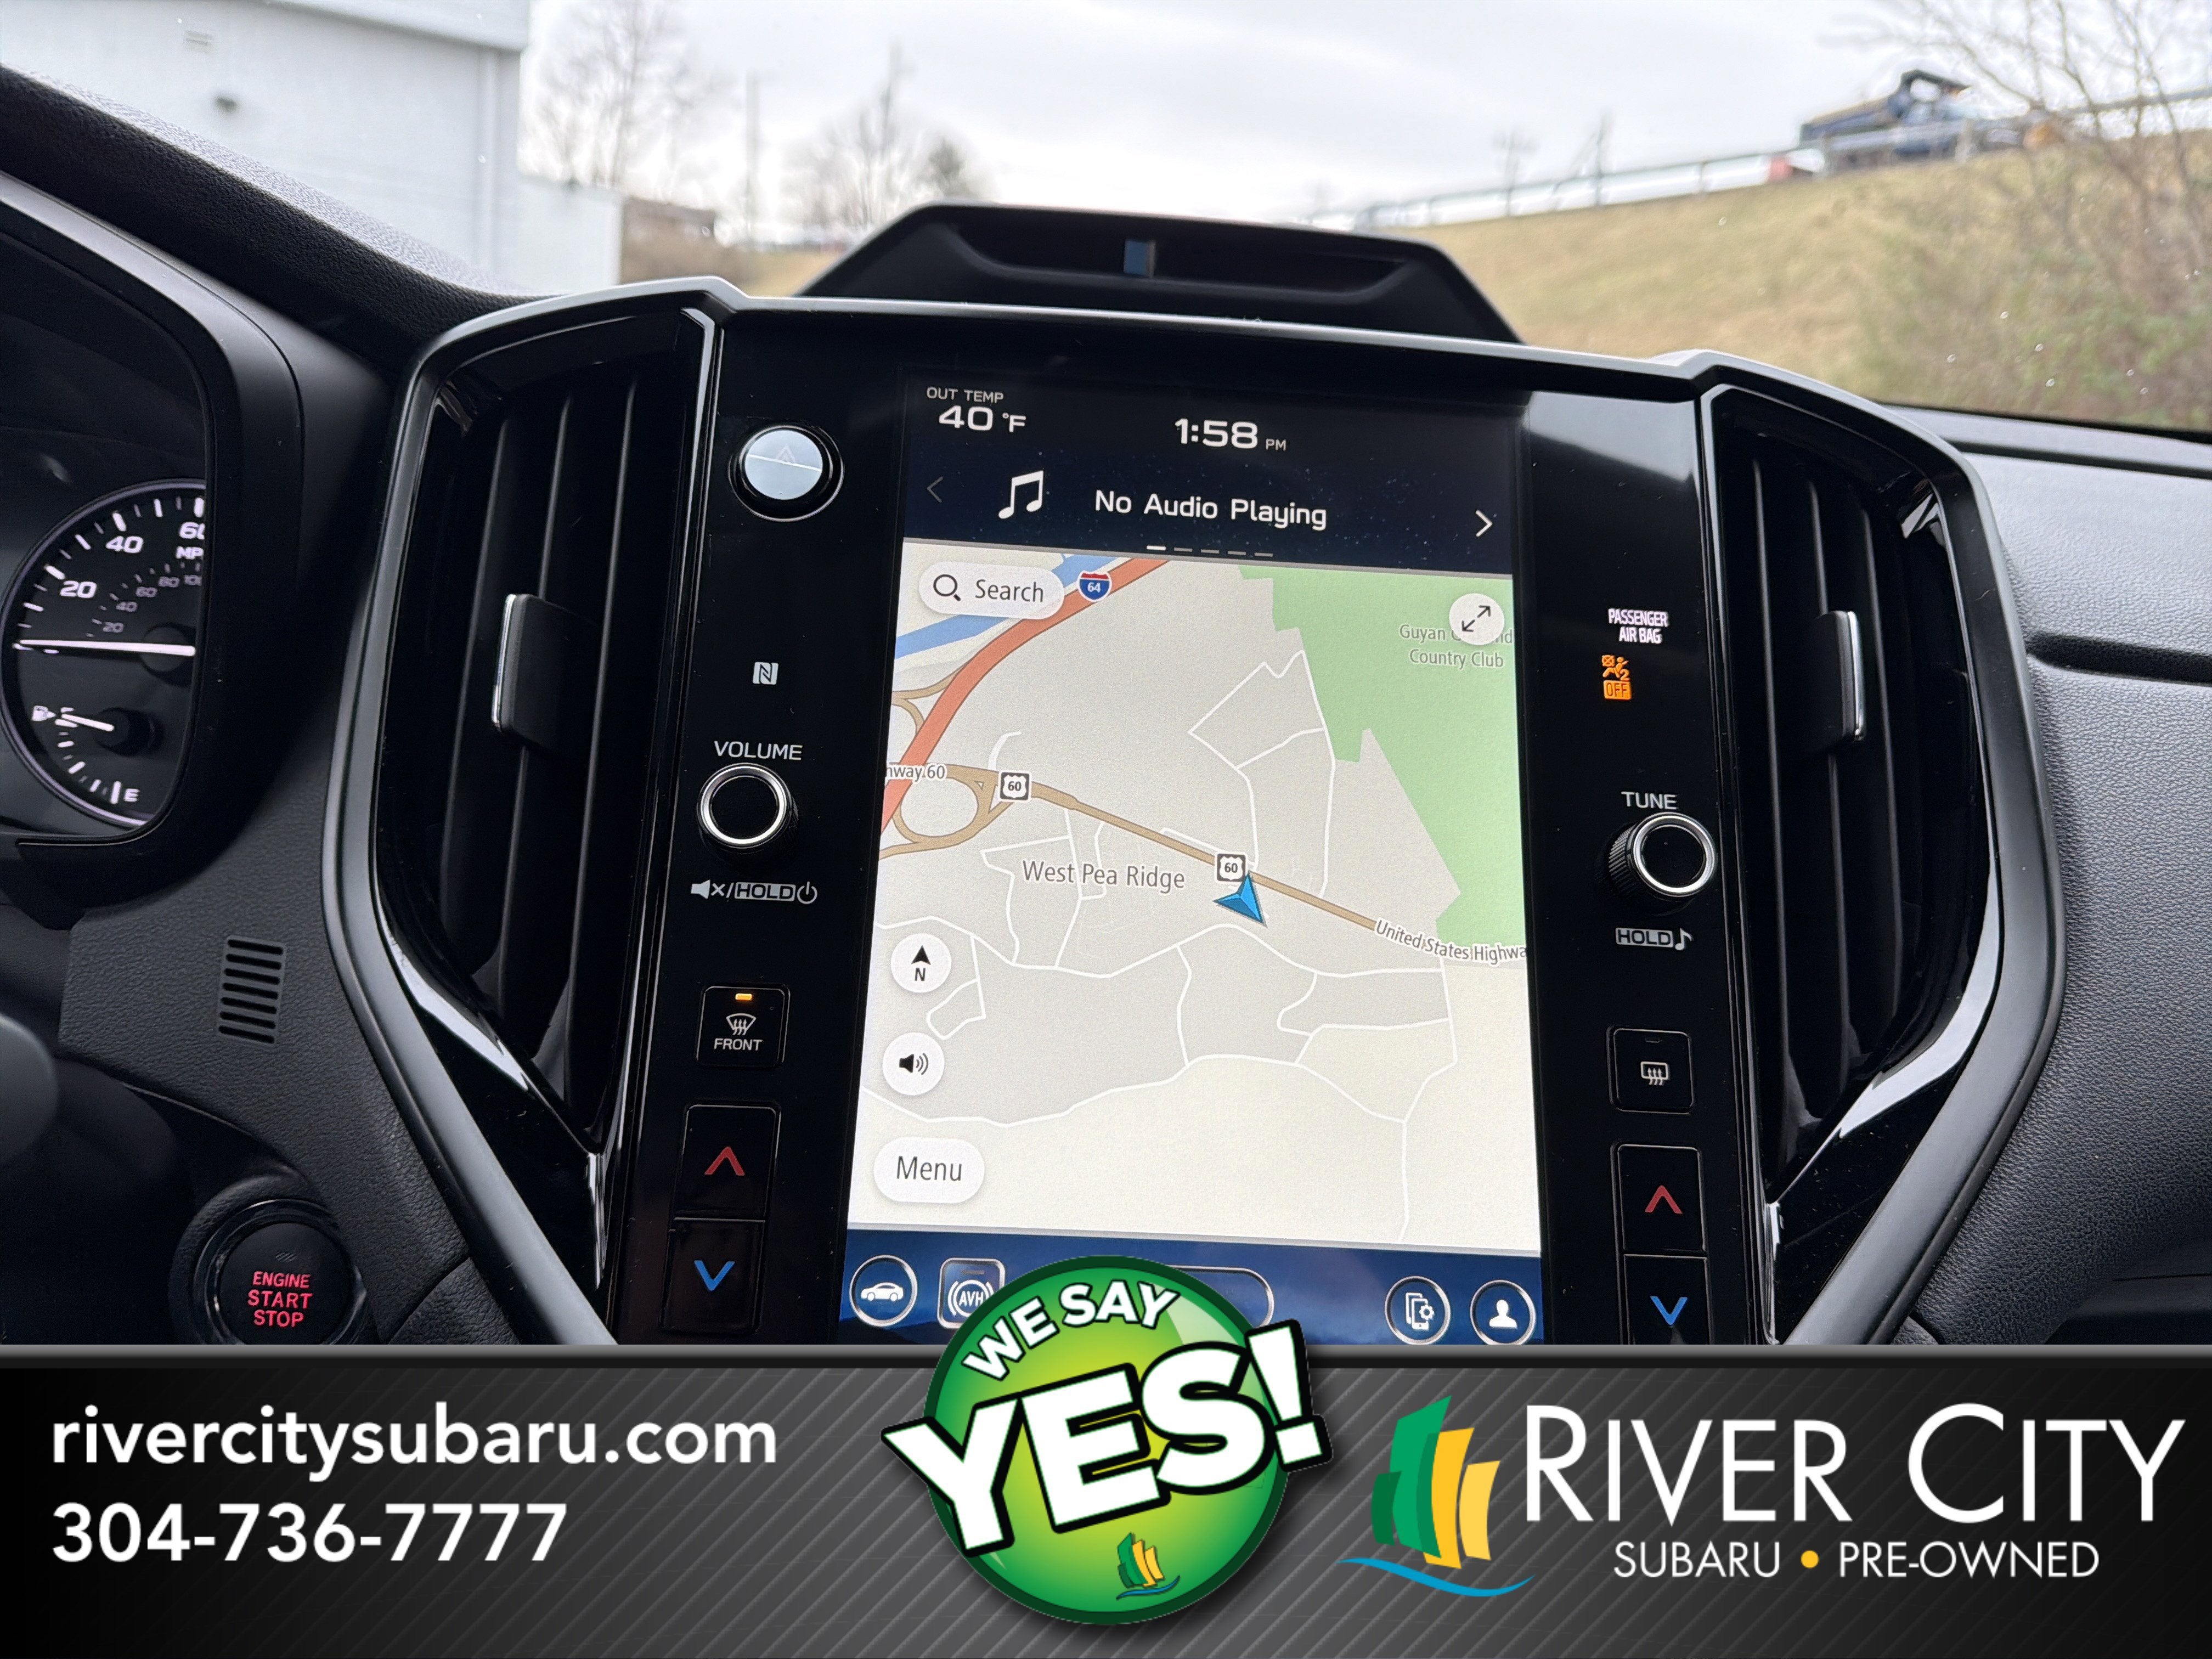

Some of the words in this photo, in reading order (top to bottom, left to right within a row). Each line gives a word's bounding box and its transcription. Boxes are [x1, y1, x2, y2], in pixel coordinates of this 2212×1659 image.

[927, 386, 958, 400] OUT
[964, 389, 1004, 403] TEMP
[939, 405, 994, 431] 40
[1175, 418, 1258, 449] 1:58
[1266, 438, 1287, 451] PM
[1096, 490, 1132, 513] No
[1144, 493, 1218, 519] Audio
[1231, 499, 1327, 531] Playing
[105, 535, 144, 554] 40
[176, 546, 204, 560] MP
[59, 580, 97, 599] 20
[975, 579, 1043, 602] Search
[1087, 582, 1101, 592] 64
[1608, 608, 1669, 627] PASSENGER
[1400, 624, 1446, 643] Guyan
[1619, 627, 1637, 642] AIR
[1638, 627, 1663, 644] BAG
[1410, 649, 1466, 669] Country
[1471, 652, 1504, 667] Club
[1606, 682, 1628, 697] OFF
[714, 741, 803, 760] VOLUME
[927, 765, 945, 779] 60
[123, 788, 140, 802] E
[1008, 781, 1022, 792] 60
[1621, 791, 1677, 810] TUNE
[1224, 862, 1238, 873] 60
[1023, 860, 1074, 883] West
[1082, 864, 1117, 885] Pea
[1127, 866, 1185, 894] Ridge
[1376, 919, 1423, 949] United
[1425, 938, 1469, 960] States
[1617, 929, 1672, 946] HOLD
[915, 967, 926, 981] N
[714, 1038, 763, 1051] FRONT
[896, 1155, 962, 1181] Menu
[252, 1271, 311, 1288] ENGINE
[247, 1289, 313, 1309] START
[959, 1290, 984, 1307] AVH
[253, 1310, 304, 1327] STOP
